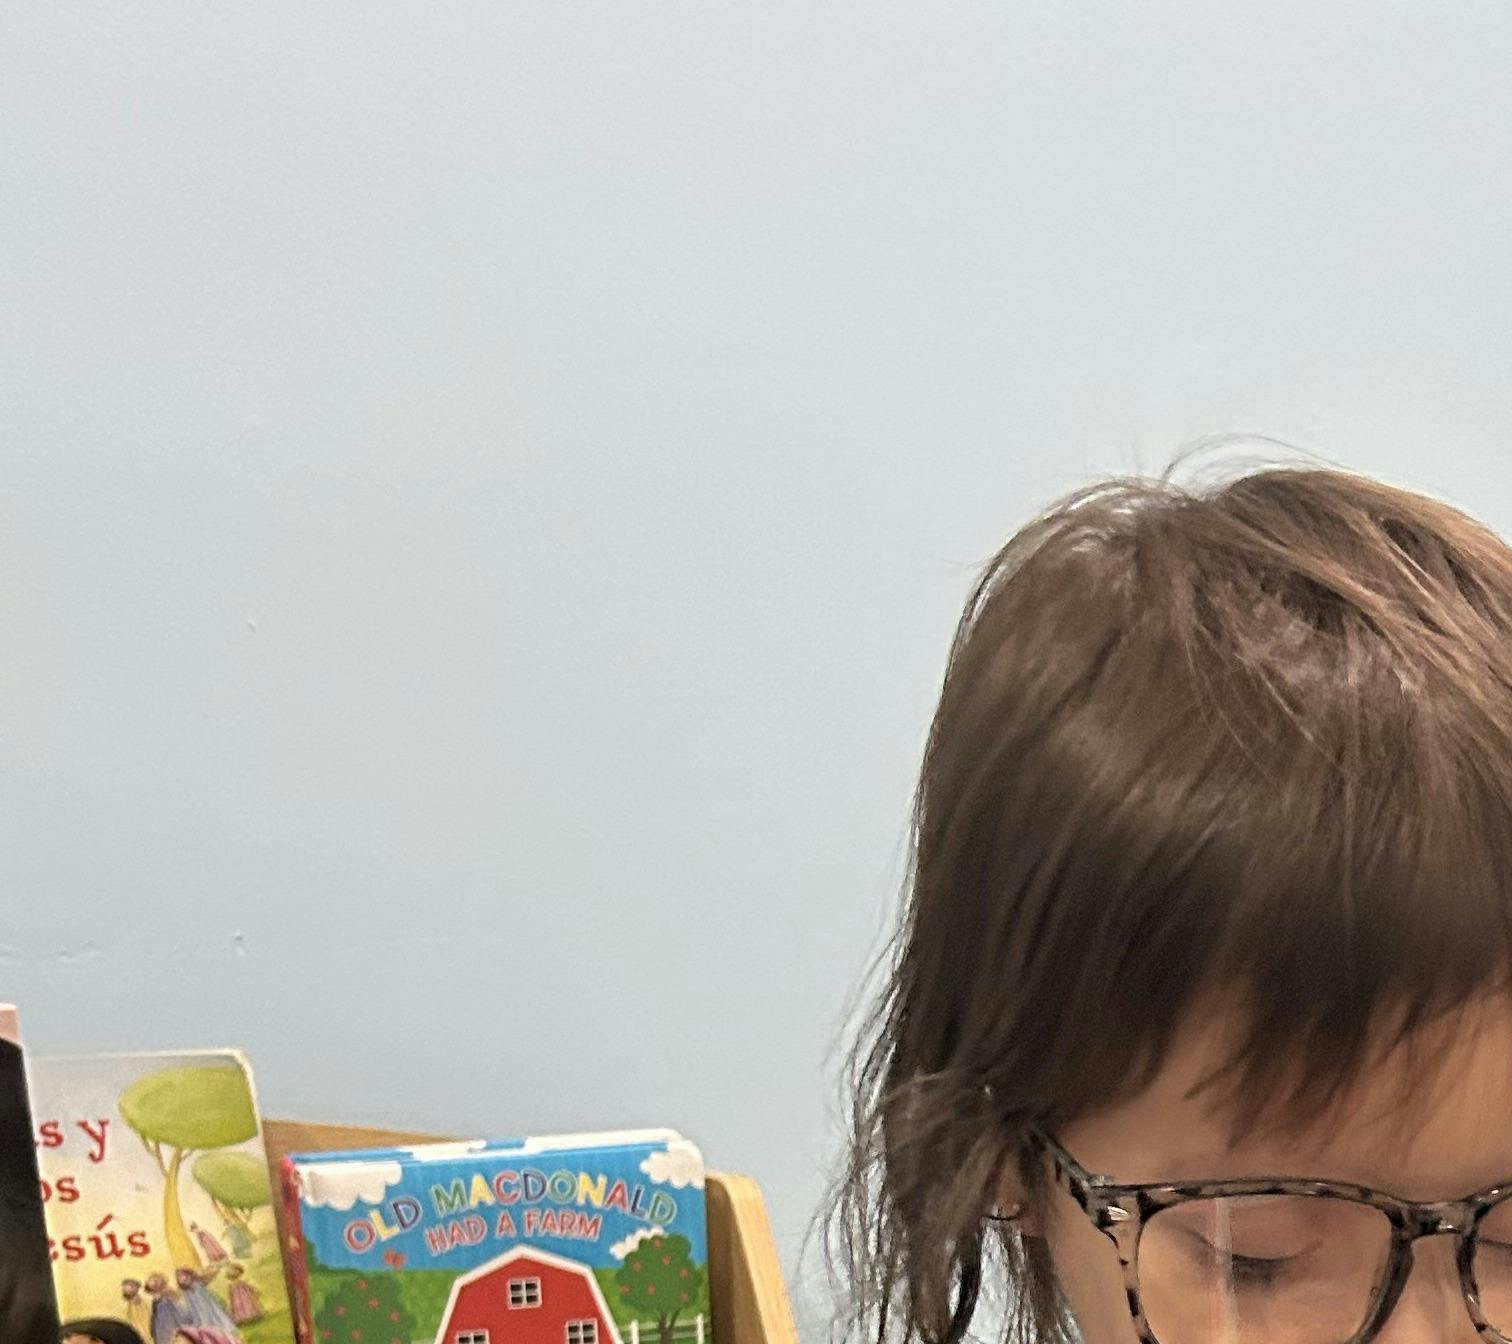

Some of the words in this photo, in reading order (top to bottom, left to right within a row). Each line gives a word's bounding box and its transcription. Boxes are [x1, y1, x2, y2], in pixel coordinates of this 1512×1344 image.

[77, 1118, 110, 1163] y
[344, 1196, 422, 1253] OLD
[430, 1170, 677, 1226] MACDONALD
[424, 1214, 488, 1255] HAD
[496, 1209, 518, 1238] A
[523, 1207, 603, 1242] FARM
